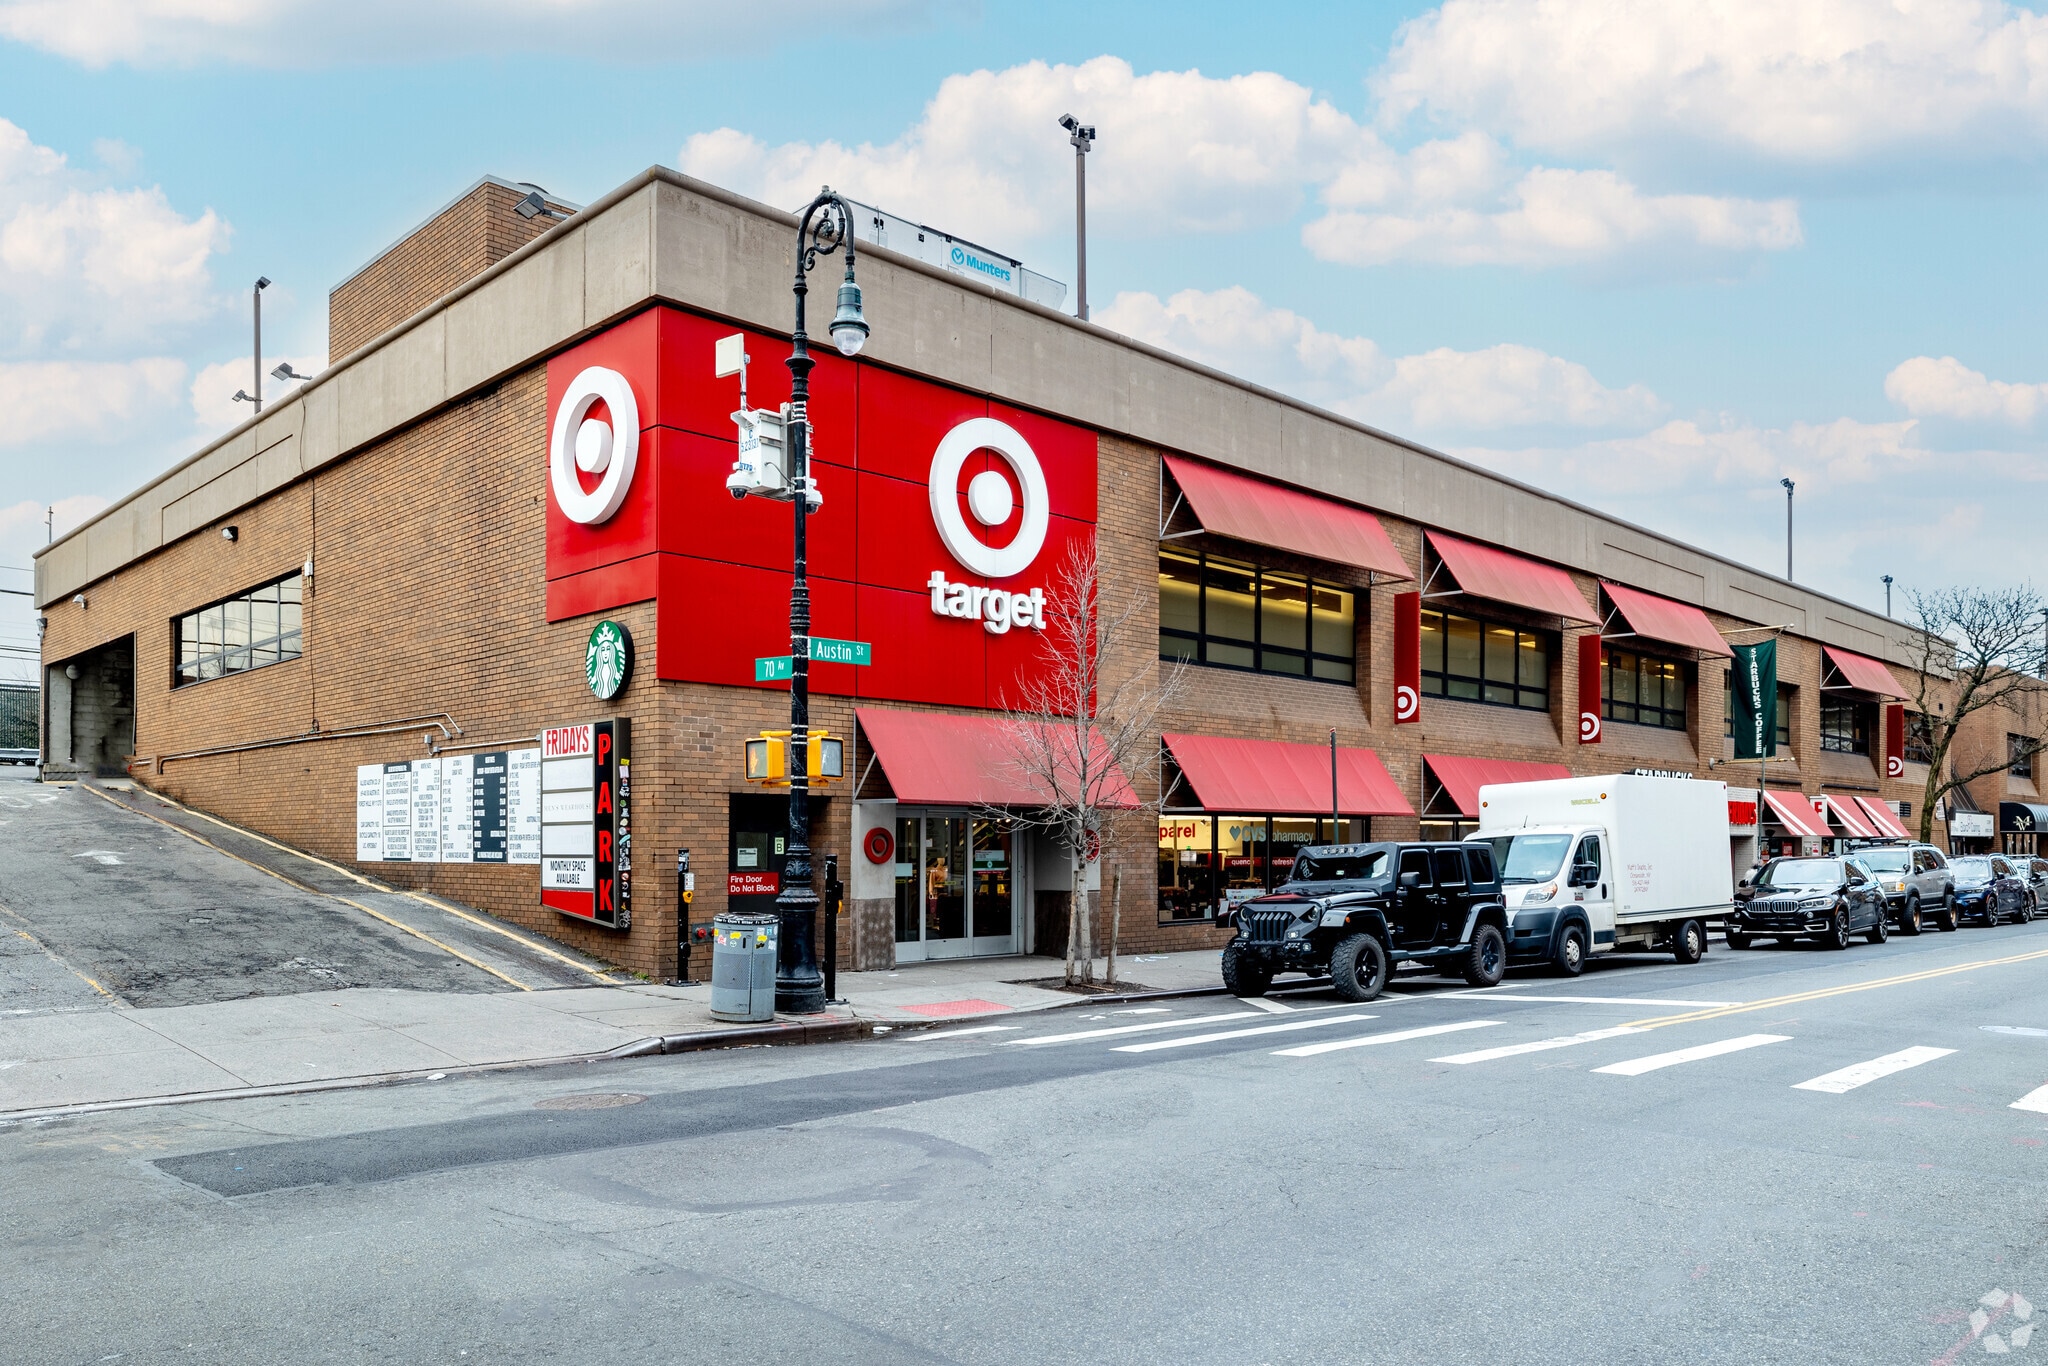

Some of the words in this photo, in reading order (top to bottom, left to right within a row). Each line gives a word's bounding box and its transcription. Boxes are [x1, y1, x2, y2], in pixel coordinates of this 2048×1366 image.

[966, 254, 1011, 282] Munters
[926, 570, 1047, 635] target
[816, 641, 852, 661] Austin
[856, 645, 864, 656] St
[764, 660, 775, 678] 70
[777, 660, 785, 671] Av
[1749, 647, 1762, 709] STARBUCKS
[546, 725, 590, 756] FRIDAYS
[1754, 712, 1763, 754] COFFEE
[596, 733, 614, 912] PARK
[1241, 825, 1267, 842] CVS
[776, 843, 783, 852] B
[550, 860, 572, 872] MONTHLY
[572, 860, 586, 872] SPACE
[556, 873, 580, 885] AVAILABLE
[730, 875, 744, 883] Fire
[745, 875, 763, 883] Door
[730, 885, 741, 893] Do
[756, 884, 775, 892] Block
